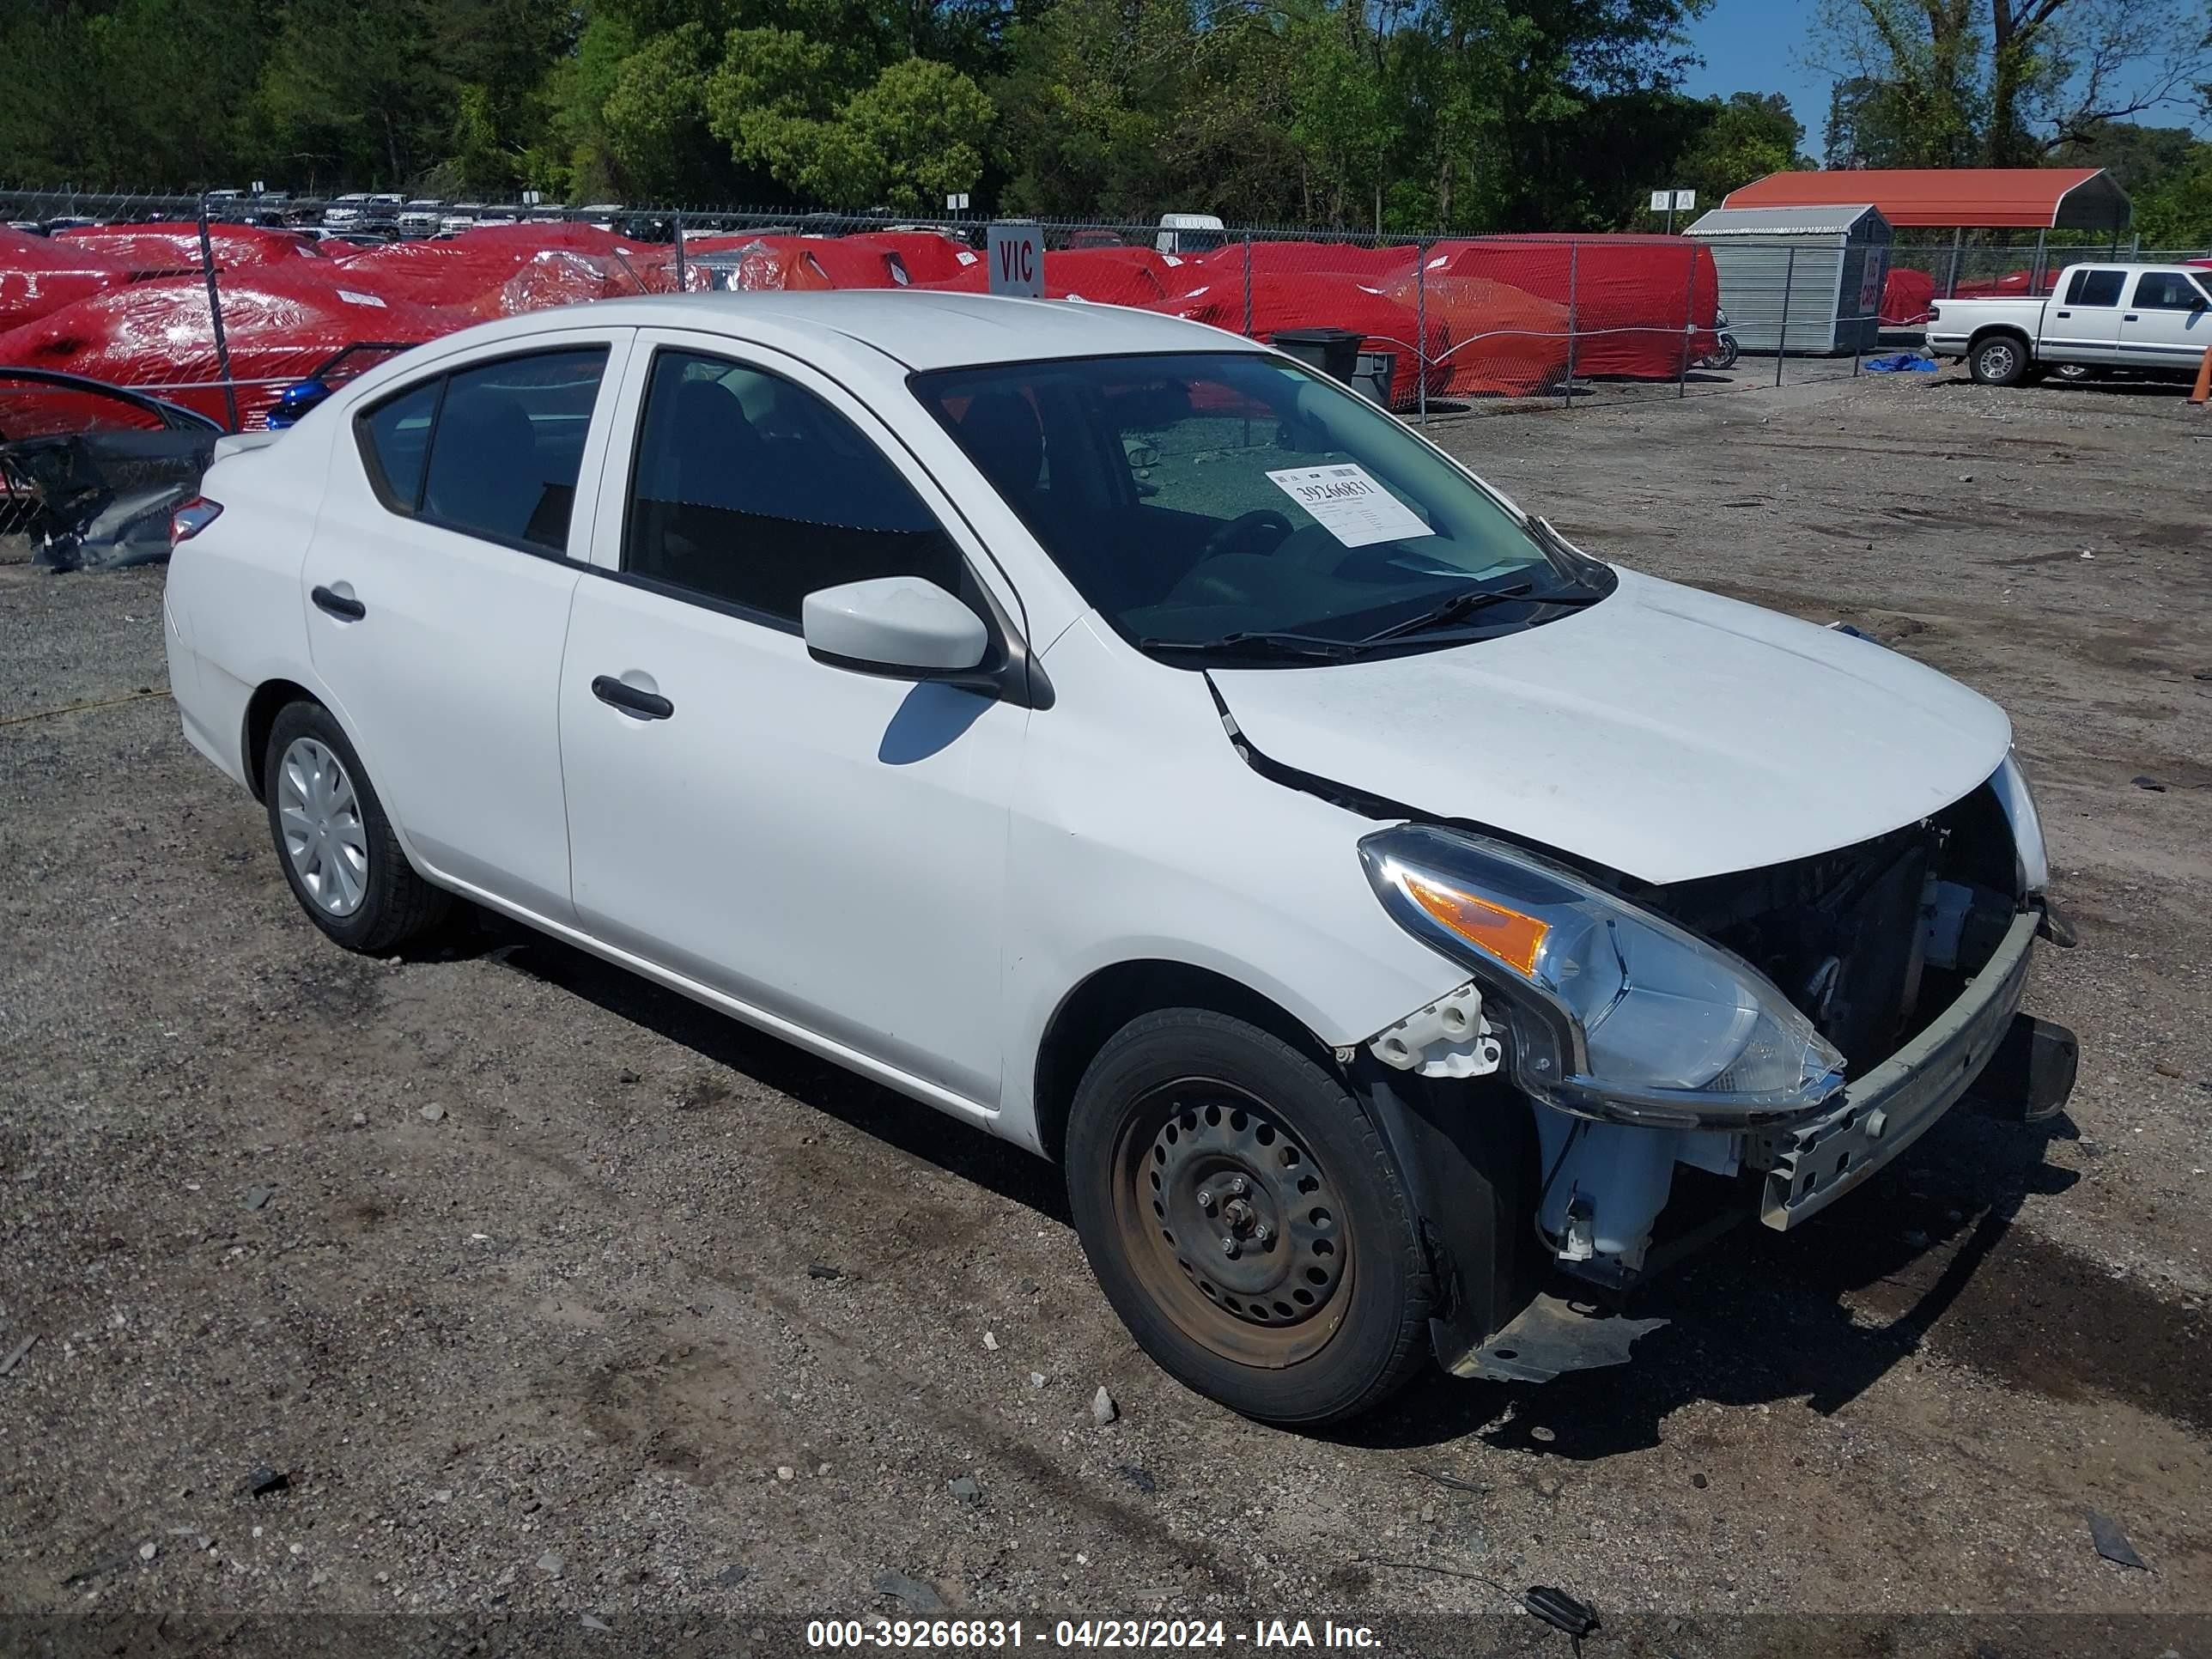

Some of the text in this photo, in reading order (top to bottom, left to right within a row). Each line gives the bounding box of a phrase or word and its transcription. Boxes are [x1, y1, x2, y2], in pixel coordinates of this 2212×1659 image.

[1655, 193, 1666, 209] B
[1679, 192, 1692, 208] A
[1000, 240, 1033, 283] VIC
[1297, 481, 1376, 501] 39266831
